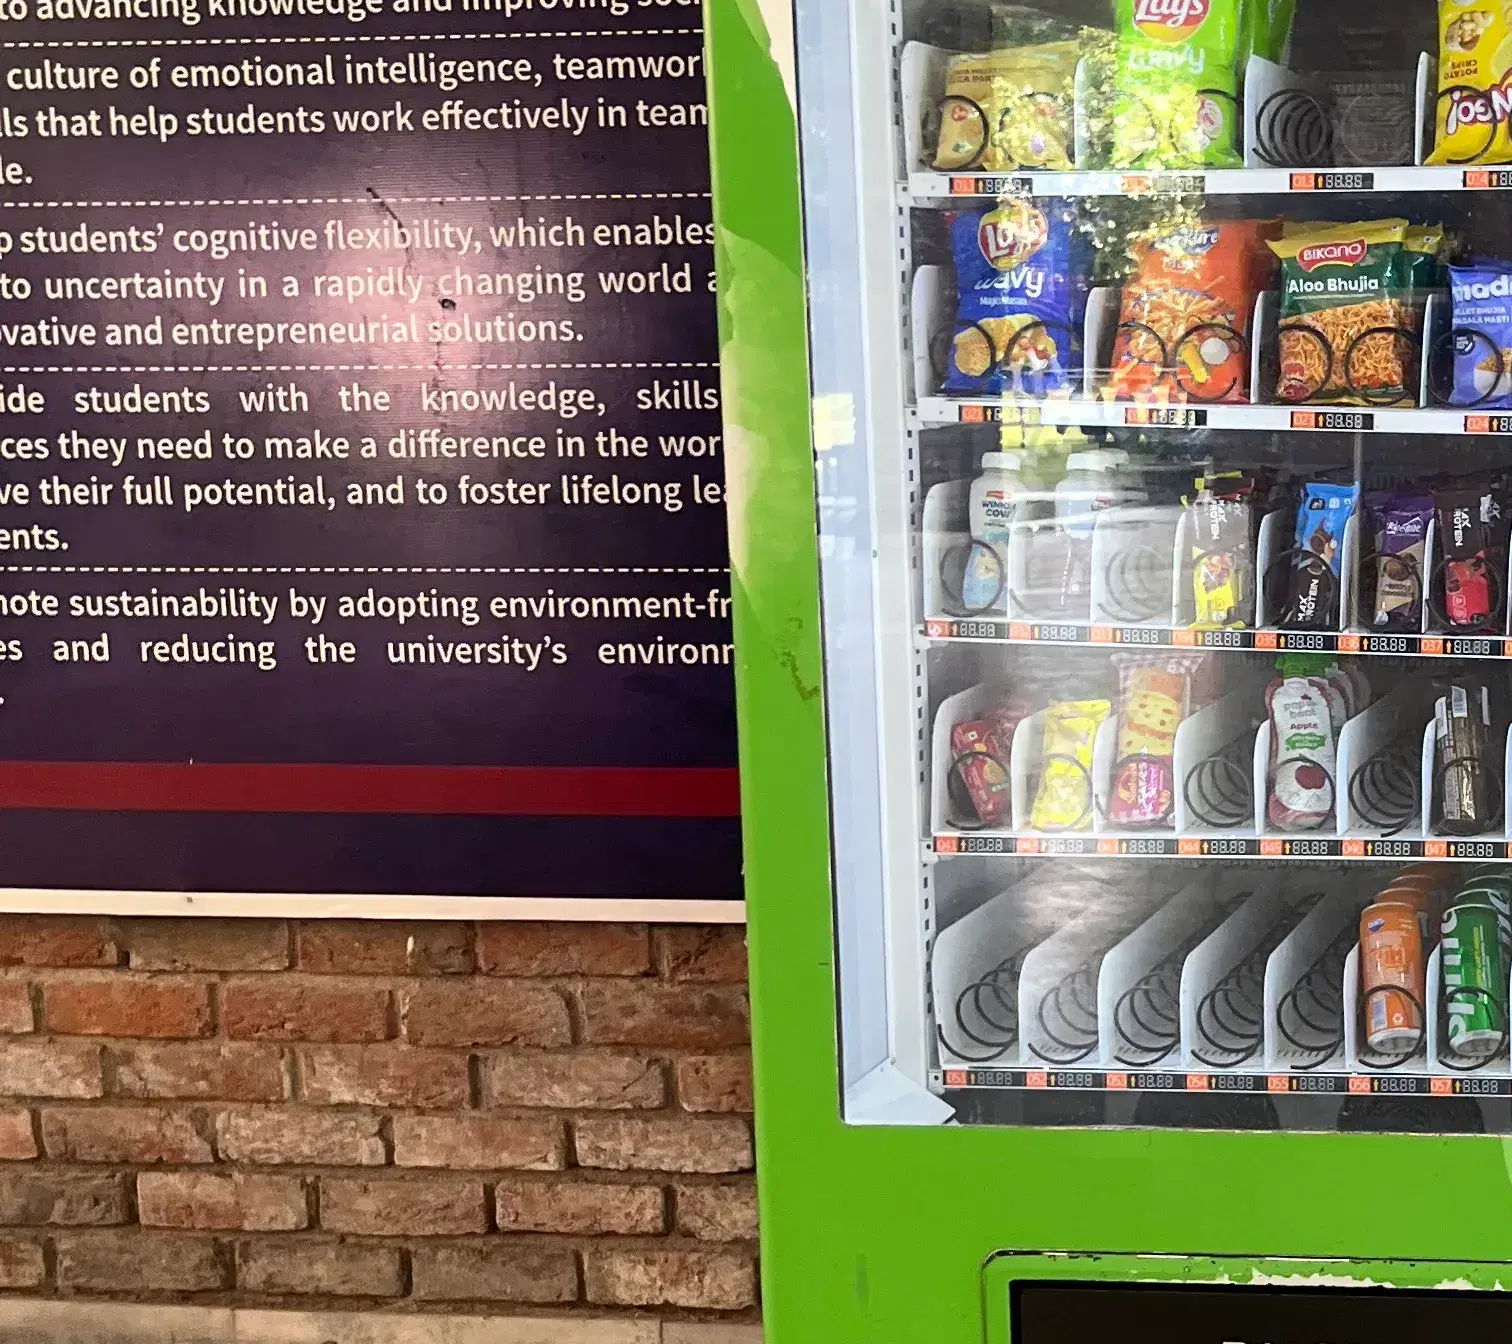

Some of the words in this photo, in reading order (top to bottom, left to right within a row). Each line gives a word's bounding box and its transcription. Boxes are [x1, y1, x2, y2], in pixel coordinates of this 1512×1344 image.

[7, 59, 118, 90] culture
[130, 57, 161, 88] of
[171, 54, 335, 87] emotional
[345, 53, 542, 90] intelligence,
[553, 47, 704, 80] teamwor
[35, 107, 102, 136] that
[109, 105, 177, 142] help
[187, 104, 325, 134] students
[333, 101, 414, 132] work
[422, 98, 589, 135] effectively
[174, 221, 317, 259] cognitive
[324, 215, 481, 255] flexibility,
[489, 216, 584, 247] which
[594, 215, 714, 246] enables
[45, 269, 224, 305] uncertainty
[315, 266, 423, 304] rapidly
[438, 265, 585, 303] changing
[598, 263, 691, 293] world
[1289, 277, 1324, 293] Aloo
[1327, 275, 1379, 296] Bhujia
[105, 316, 162, 345] and
[172, 313, 420, 351] entrepreneurial
[427, 312, 583, 344] solutions.
[75, 384, 210, 413] students
[239, 383, 308, 412] with
[338, 383, 390, 412] the
[421, 381, 605, 418] knowledge,
[637, 380, 718, 409] skills
[58, 430, 126, 466] they
[137, 430, 212, 459] need
[265, 429, 349, 458] make
[389, 429, 545, 458] difference
[39, 476, 113, 505] their
[122, 476, 173, 505] full
[184, 476, 335, 512] potential,
[347, 475, 404, 504] and
[458, 475, 551, 504] foster
[562, 475, 683, 512] lifelong
[70, 588, 278, 624] sustainability
[290, 588, 326, 624] by
[339, 588, 480, 625] adopting
[53, 633, 109, 661] and
[141, 634, 276, 670] reducing
[305, 634, 356, 662] the
